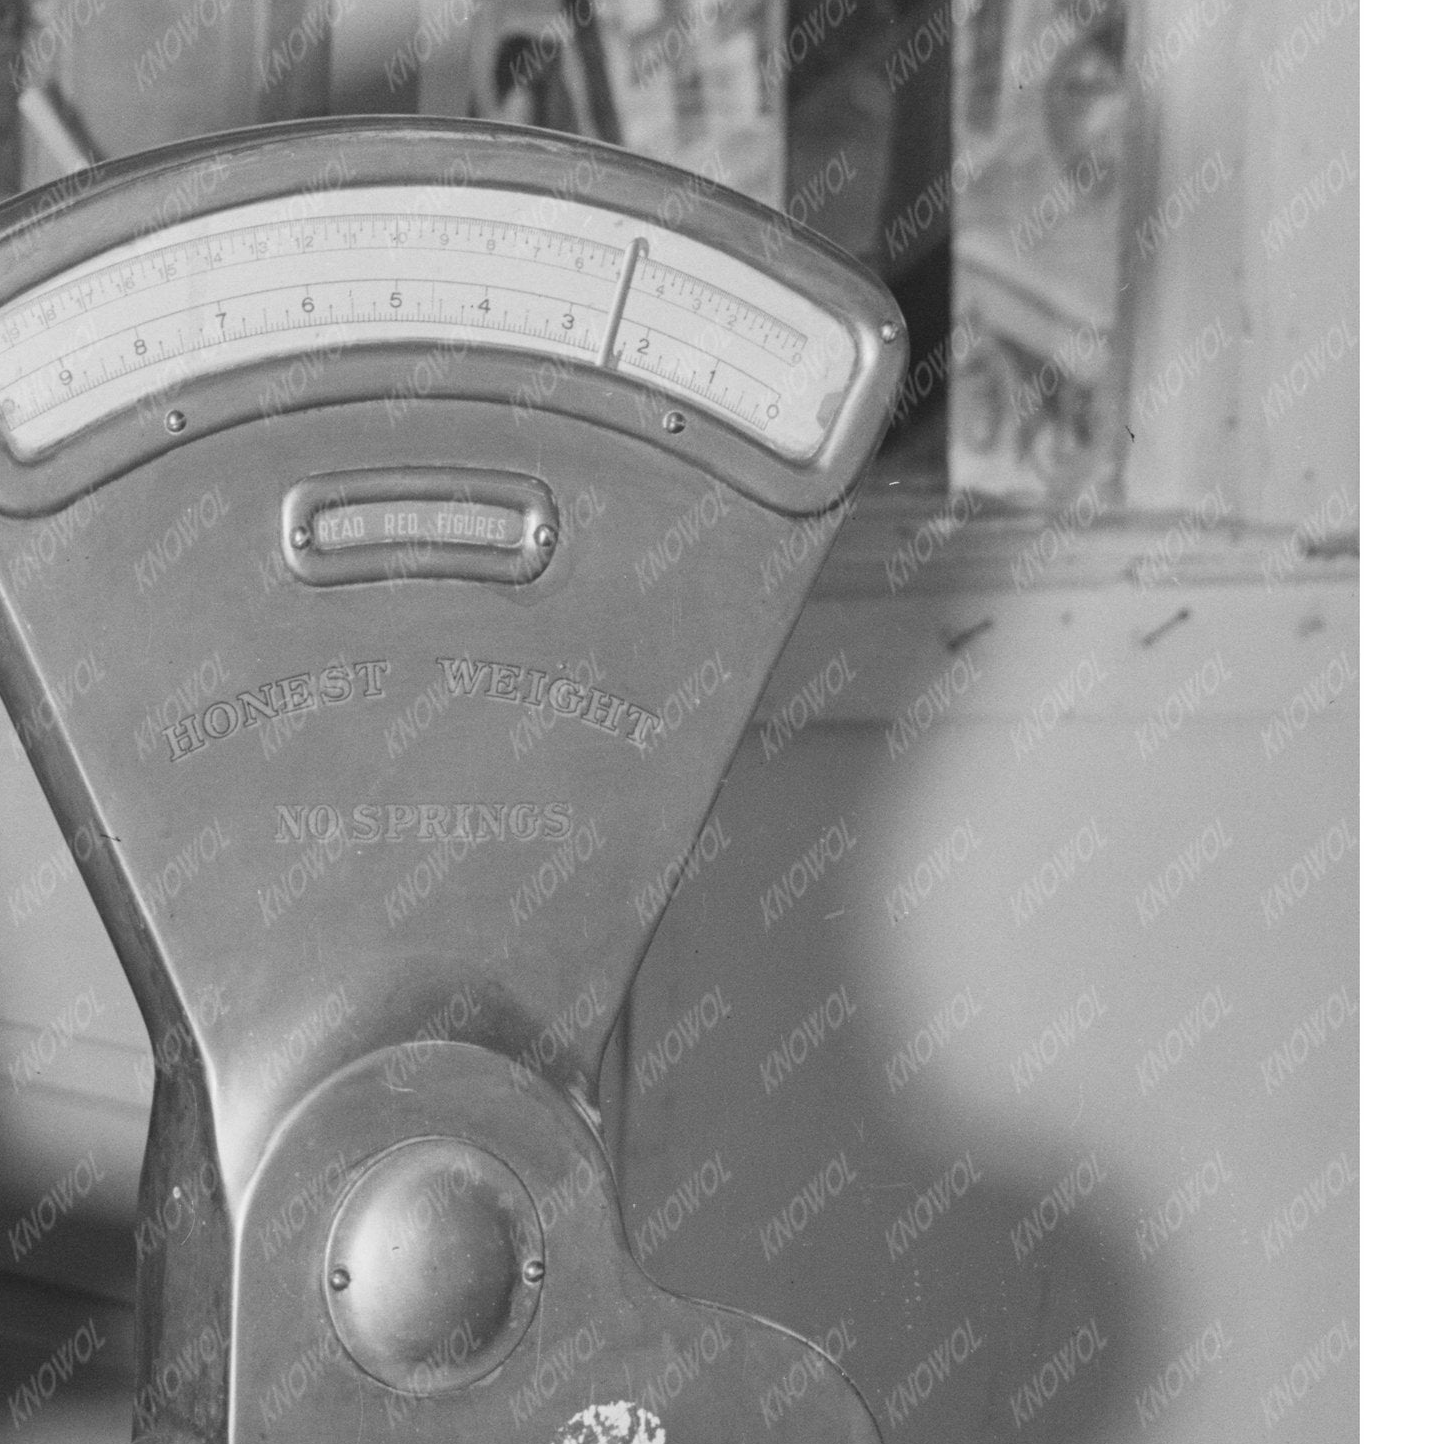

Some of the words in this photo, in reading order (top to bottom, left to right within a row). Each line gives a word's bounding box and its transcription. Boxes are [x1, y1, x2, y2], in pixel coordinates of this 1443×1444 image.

[439, 233, 449, 246] 9
[58, 369, 74, 386] 9
[133, 339, 148, 356] 8
[215, 312, 228, 330] 7
[301, 296, 315, 313] 6
[389, 292, 403, 309] 5
[477, 297, 492, 314] 4
[561, 314, 576, 331] 3
[636, 337, 651, 356] 2
[766, 403, 780, 420] 0
[317, 516, 365, 543] READ
[383, 513, 419, 536] RED
[437, 511, 507, 540] FIGURES
[161, 658, 391, 762] HONEST
[435, 656, 665, 749] WEIGHT
[274, 803, 343, 843] NO
[350, 801, 575, 844] SPRINGS
